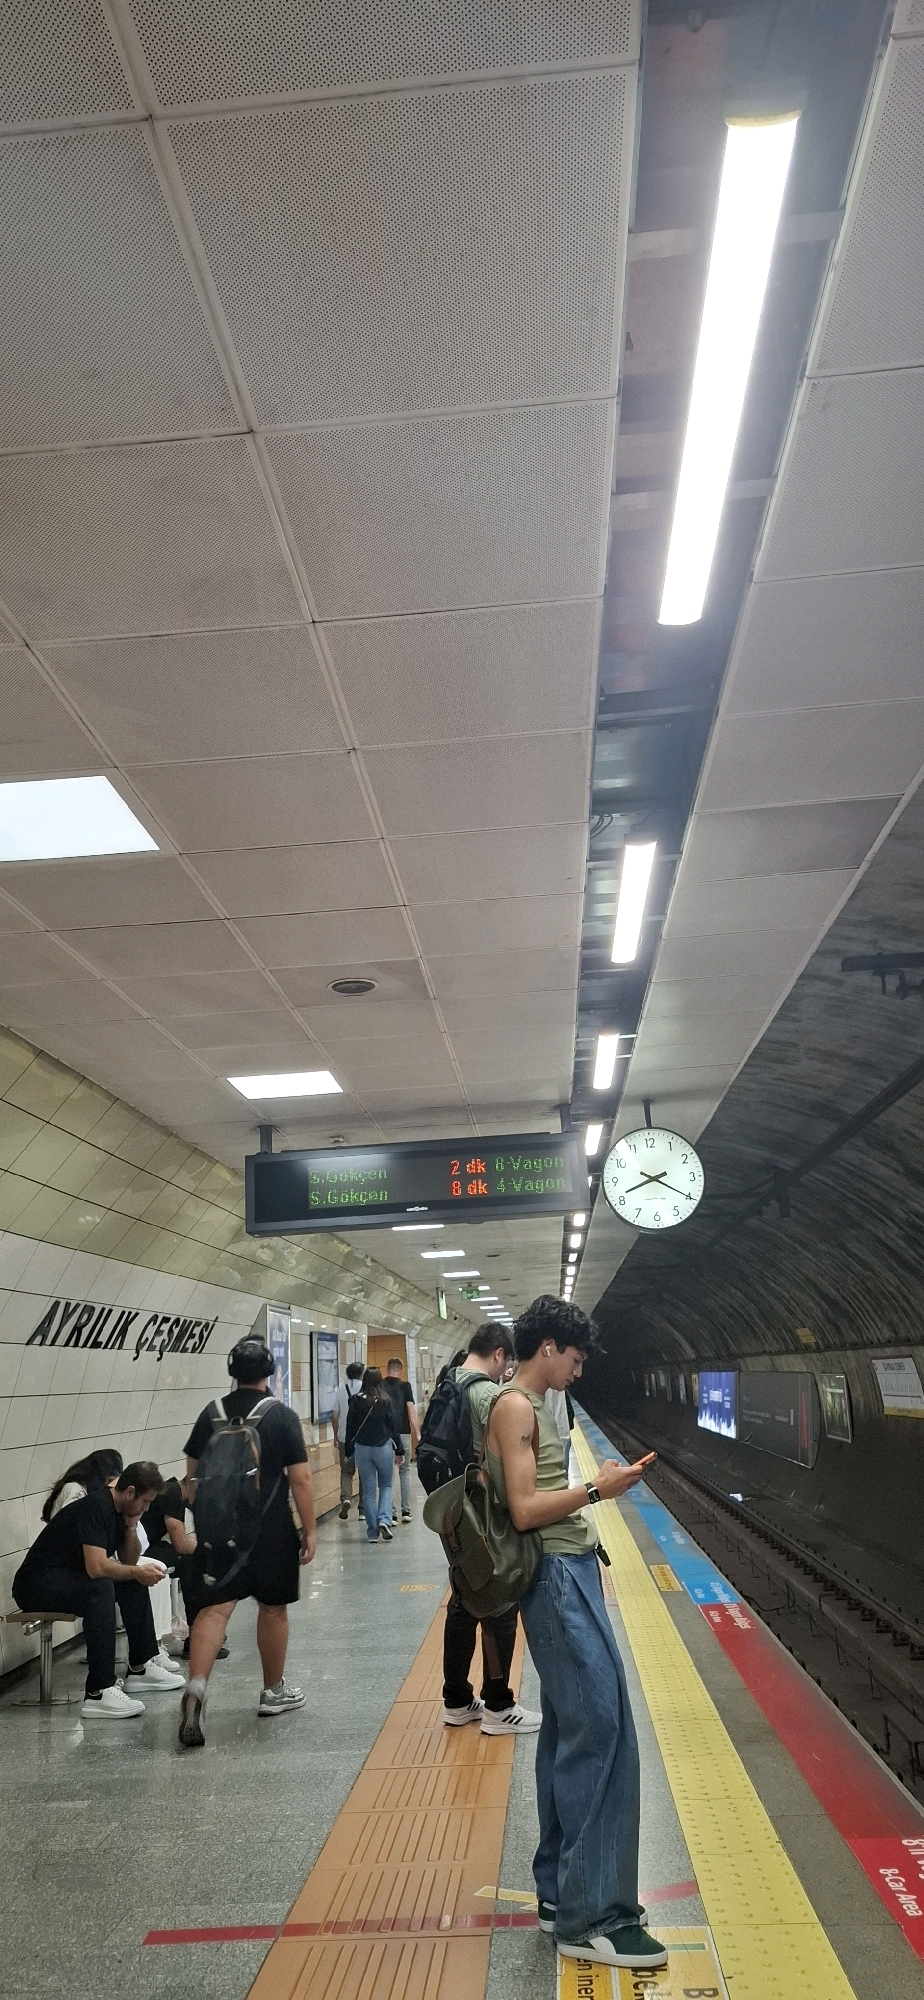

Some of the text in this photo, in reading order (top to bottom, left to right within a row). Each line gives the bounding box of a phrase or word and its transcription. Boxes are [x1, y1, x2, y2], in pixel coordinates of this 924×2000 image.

[644, 1137, 655, 1149] 12
[616, 1157, 627, 1169] 10
[681, 1153, 689, 1165] 2
[450, 1159, 461, 1175] 2
[466, 1158, 487, 1174] dk
[495, 1156, 564, 1172] 8-Vagon
[611, 1176, 619, 1187] 9
[689, 1171, 696, 1182] 3
[451, 1180, 462, 1197] 8
[467, 1179, 488, 1195] dk
[496, 1176, 566, 1194] 4-Vagon
[618, 1195, 626, 1206] 8
[635, 1207, 642, 1219] 7
[653, 1211, 661, 1222] 6
[672, 1205, 680, 1217] 5
[26, 1300, 219, 1362] AYRILIK ÇEŞMESİ
[879, 1868, 923, 1917] 8-Car Area
